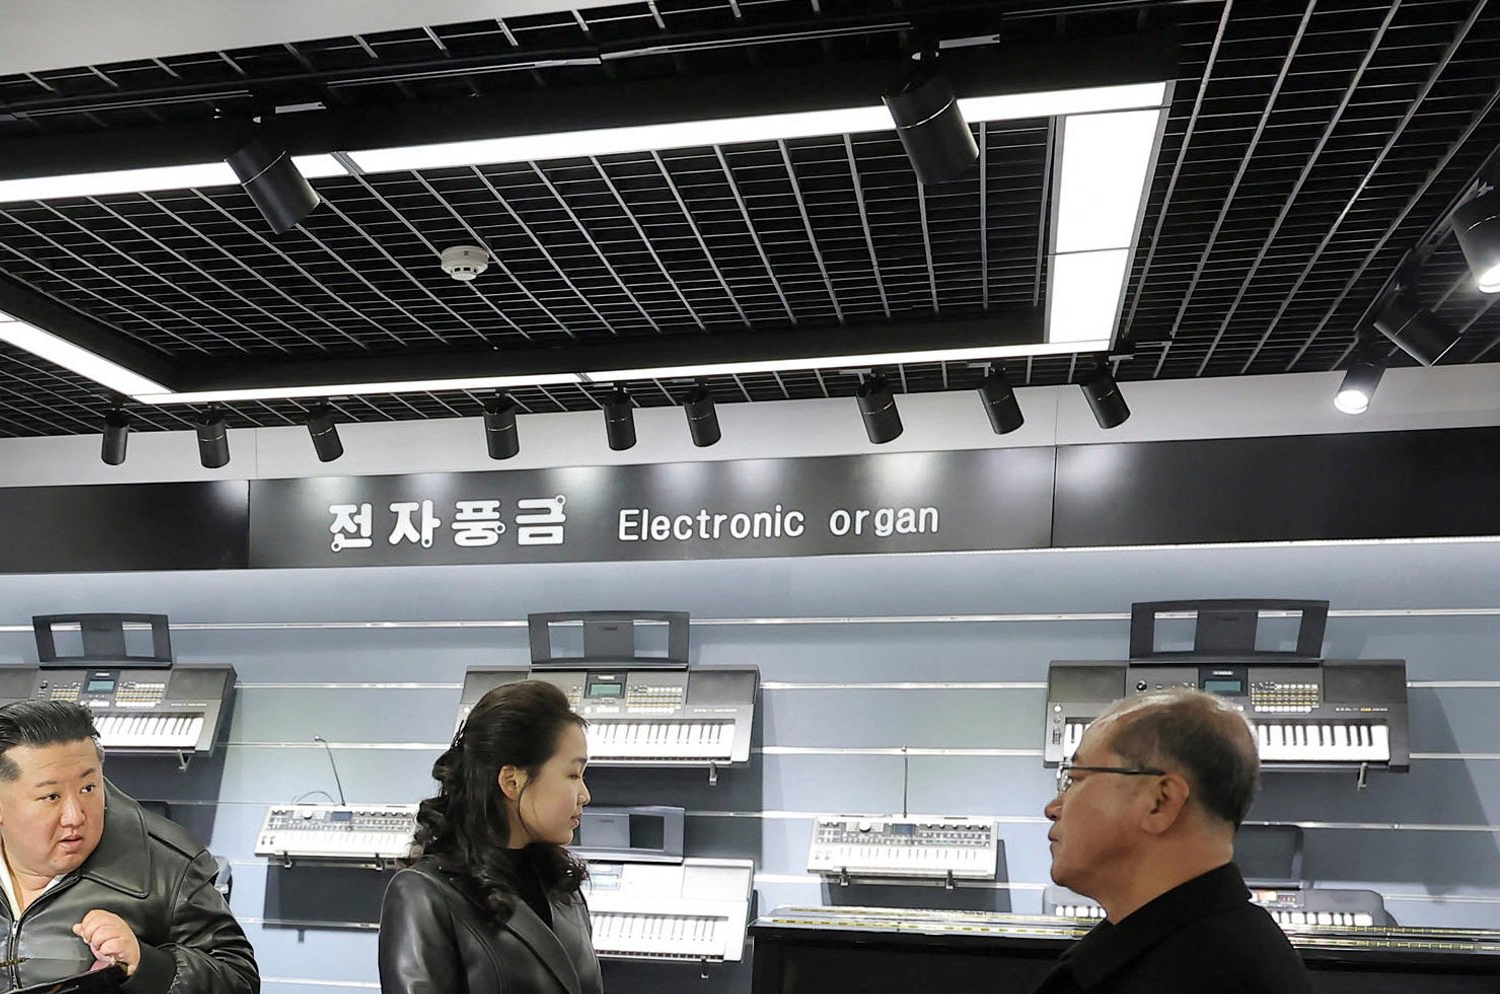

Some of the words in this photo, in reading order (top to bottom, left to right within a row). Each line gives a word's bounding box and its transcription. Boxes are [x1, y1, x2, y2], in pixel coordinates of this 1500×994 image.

[329, 494, 567, 552] 전자풍금
[618, 503, 805, 542] Electronic
[828, 505, 939, 538] organ
